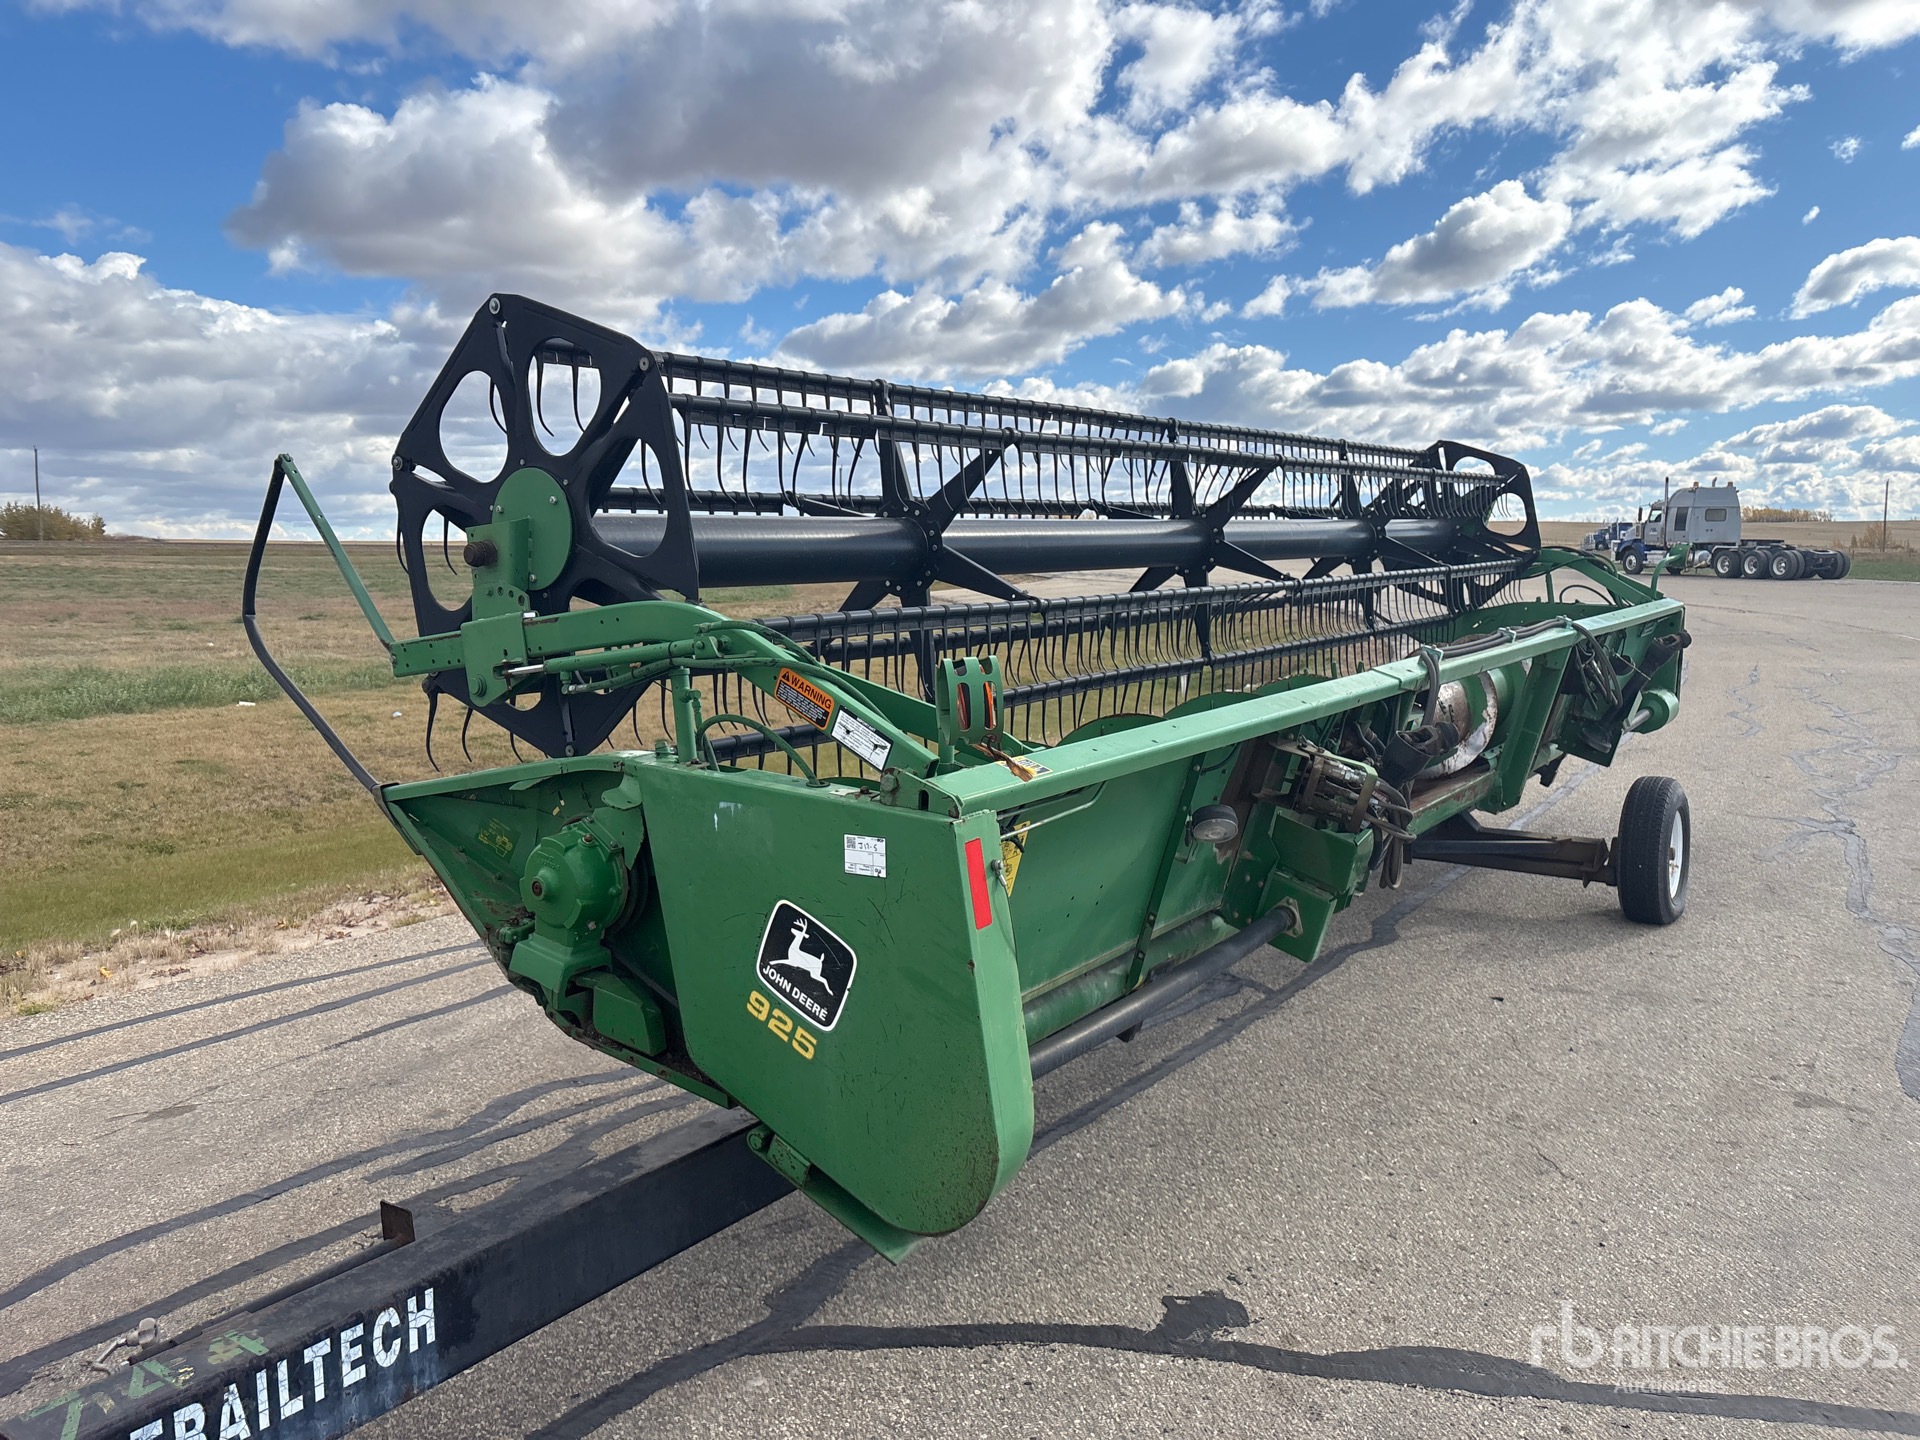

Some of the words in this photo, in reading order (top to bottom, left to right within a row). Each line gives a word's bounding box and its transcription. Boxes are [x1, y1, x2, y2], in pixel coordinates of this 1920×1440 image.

[791, 675, 832, 709] WARNING
[763, 965, 792, 993] JOHN
[792, 987, 828, 1021] DEERE
[746, 990, 817, 1060] 925
[129, 1287, 437, 1440] RAILTECH
